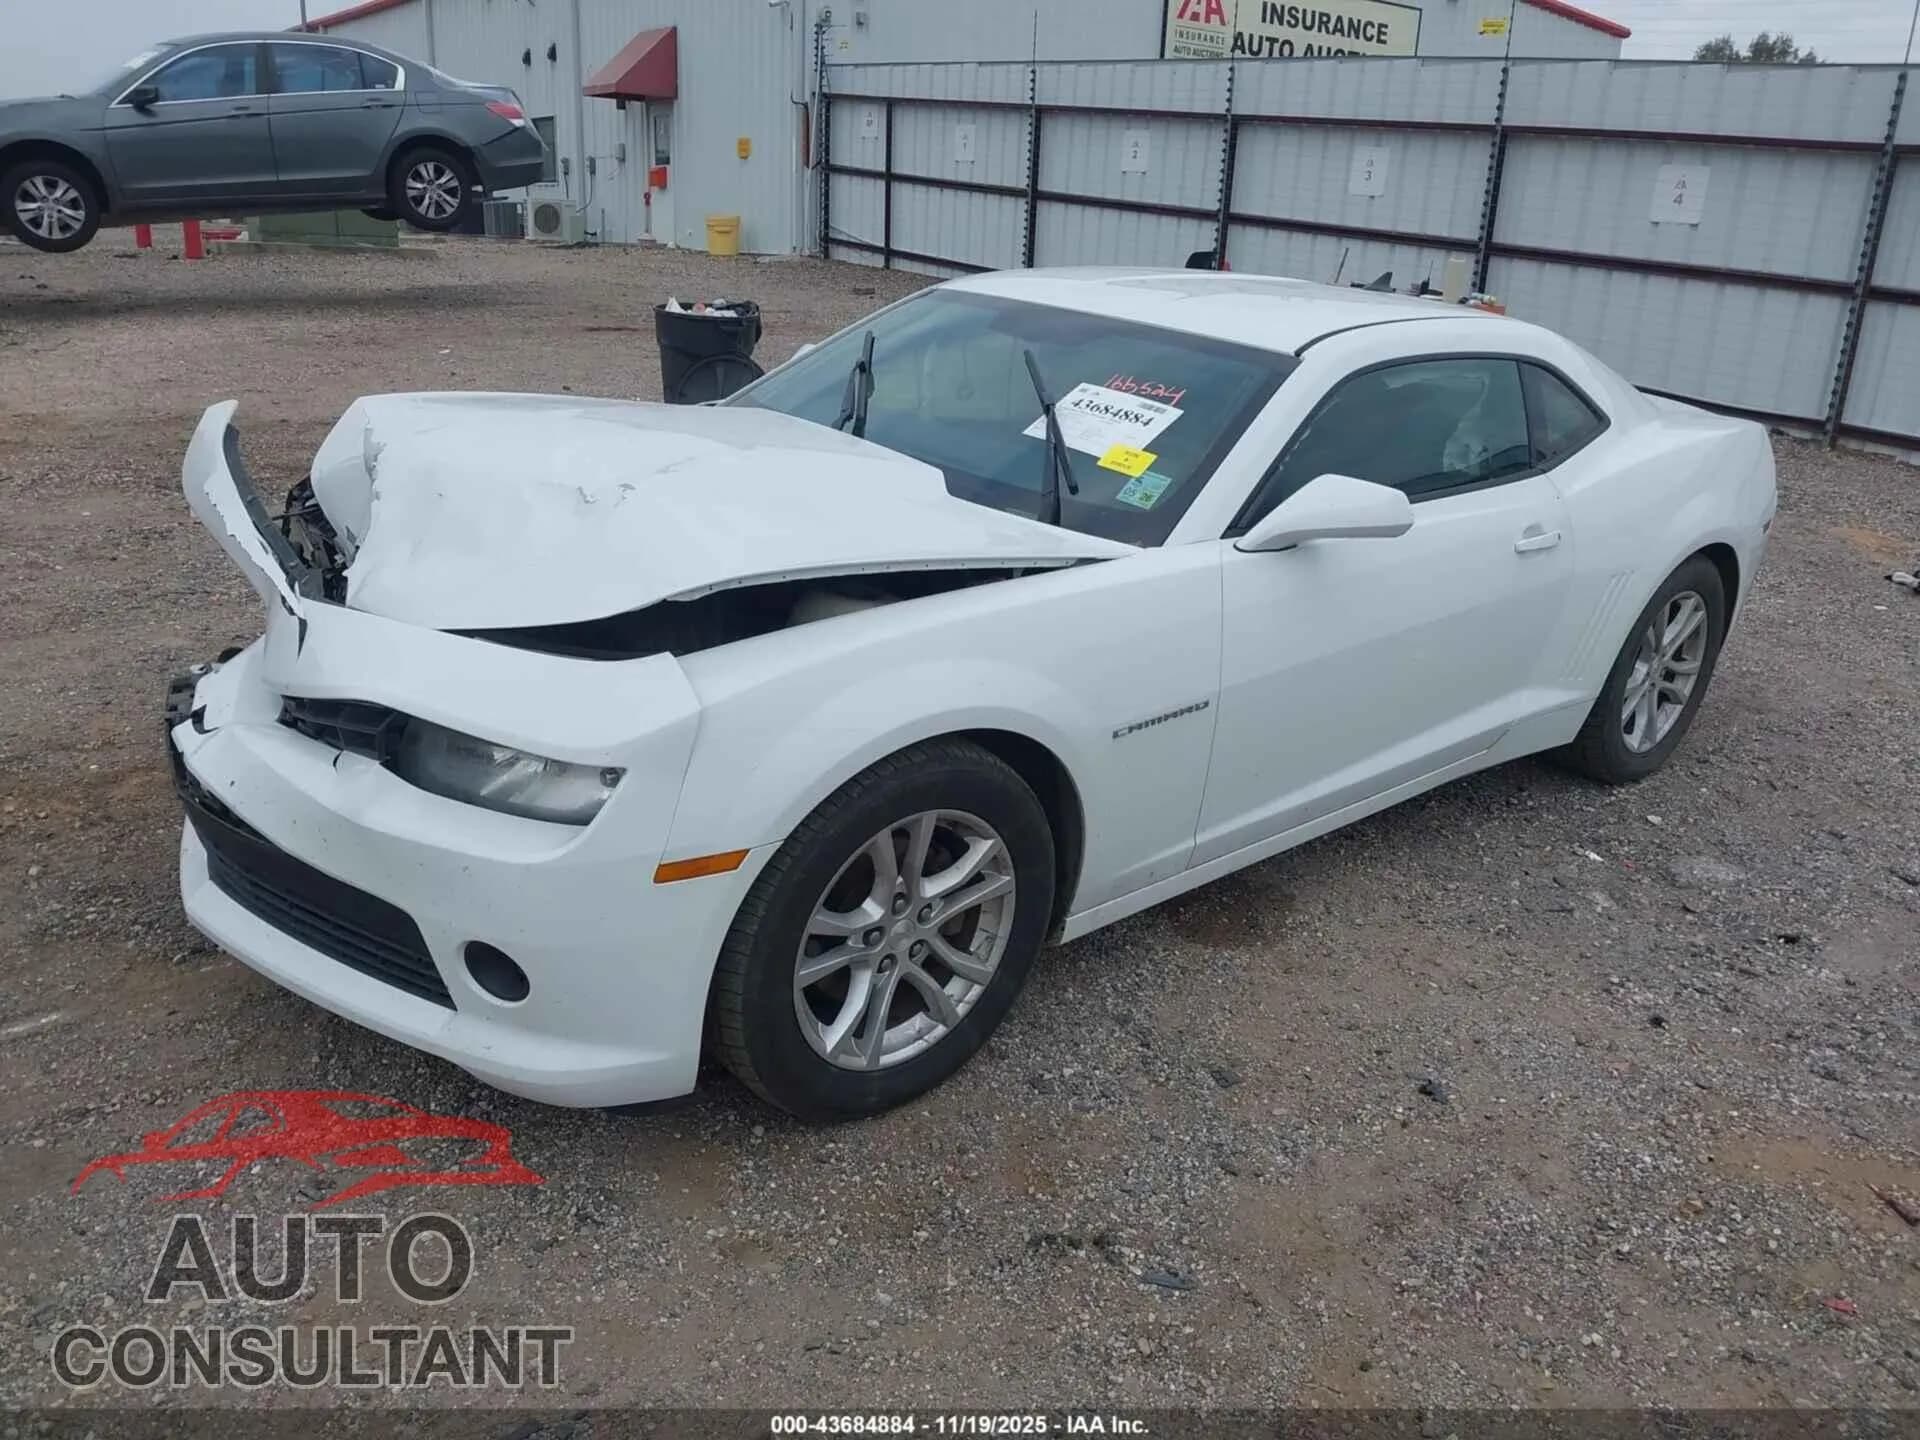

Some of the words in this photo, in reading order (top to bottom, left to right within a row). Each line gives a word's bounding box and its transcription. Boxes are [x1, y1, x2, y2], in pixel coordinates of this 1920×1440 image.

[1174, 28, 1225, 46] INSURANCE
[1261, 1, 1389, 45] INSURANCE
[1230, 31, 1295, 57] AUTO
[1672, 193, 1683, 206] 4
[1071, 397, 1154, 428] 43684884
[1112, 699, 1210, 740] CAMARO
